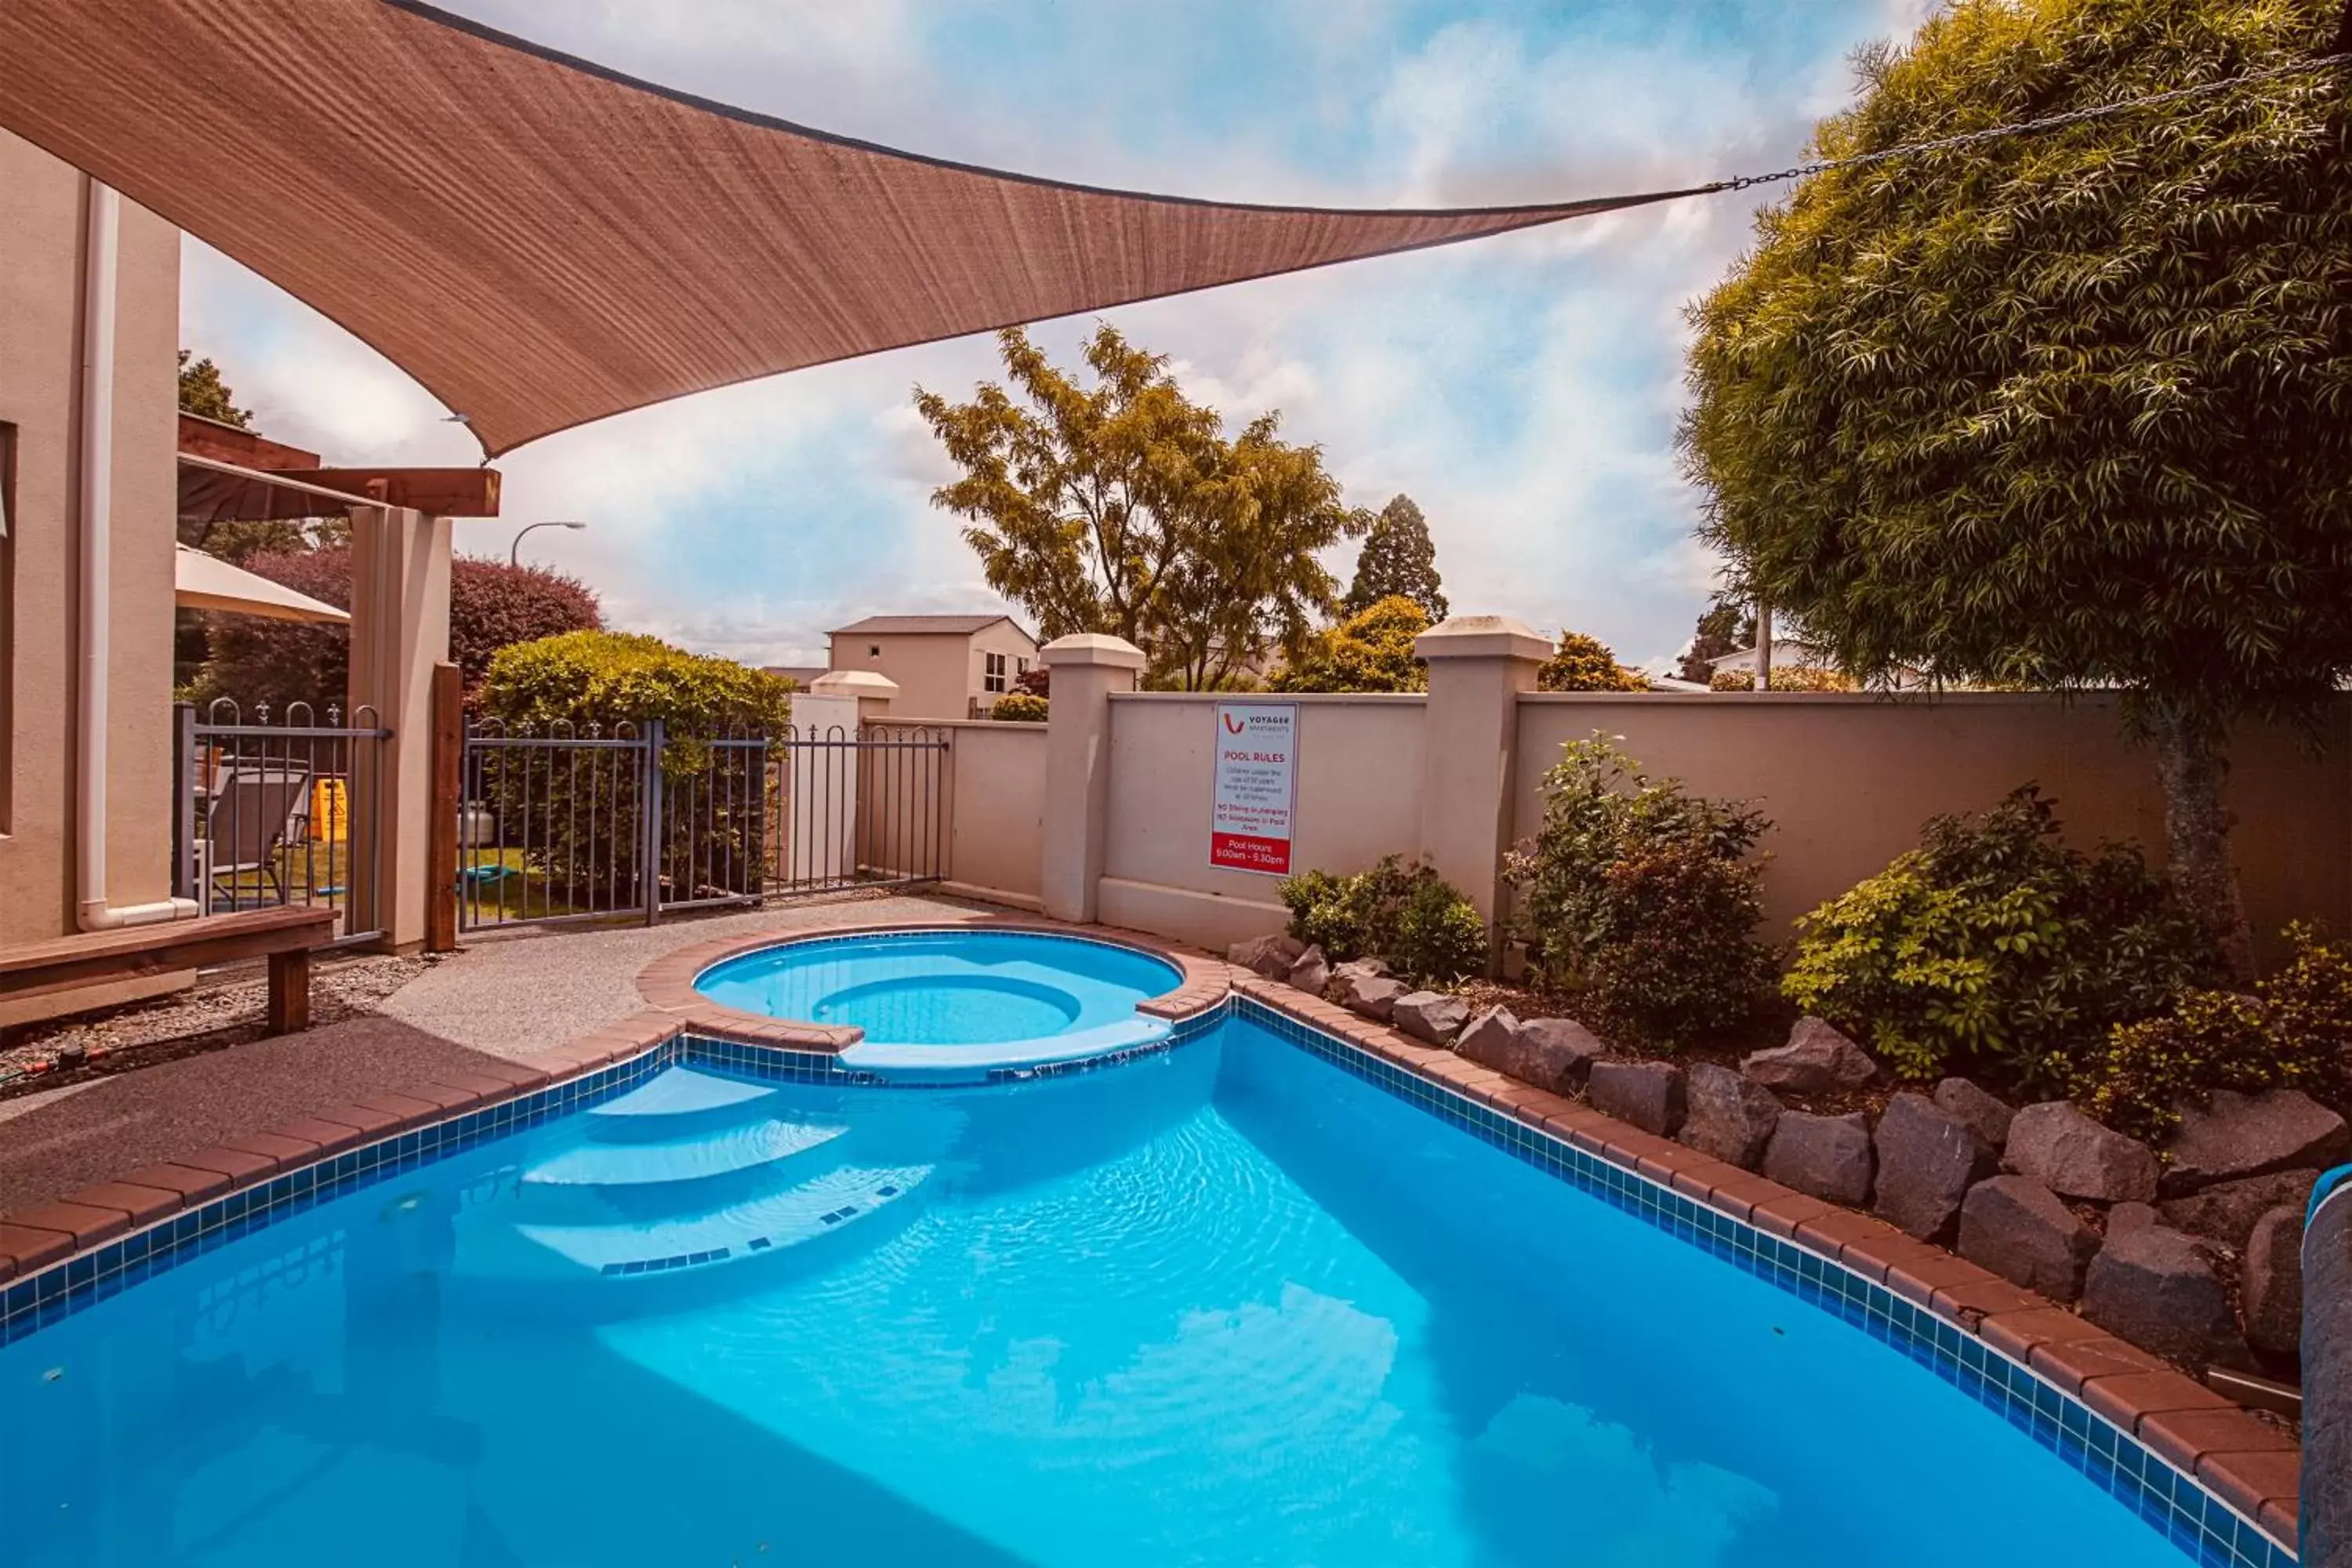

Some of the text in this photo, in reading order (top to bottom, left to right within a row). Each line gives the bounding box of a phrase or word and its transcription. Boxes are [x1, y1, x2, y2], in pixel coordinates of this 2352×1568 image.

[1225, 751, 1285, 763] POOL RULES
[1229, 840, 1272, 853] Pool Hours
